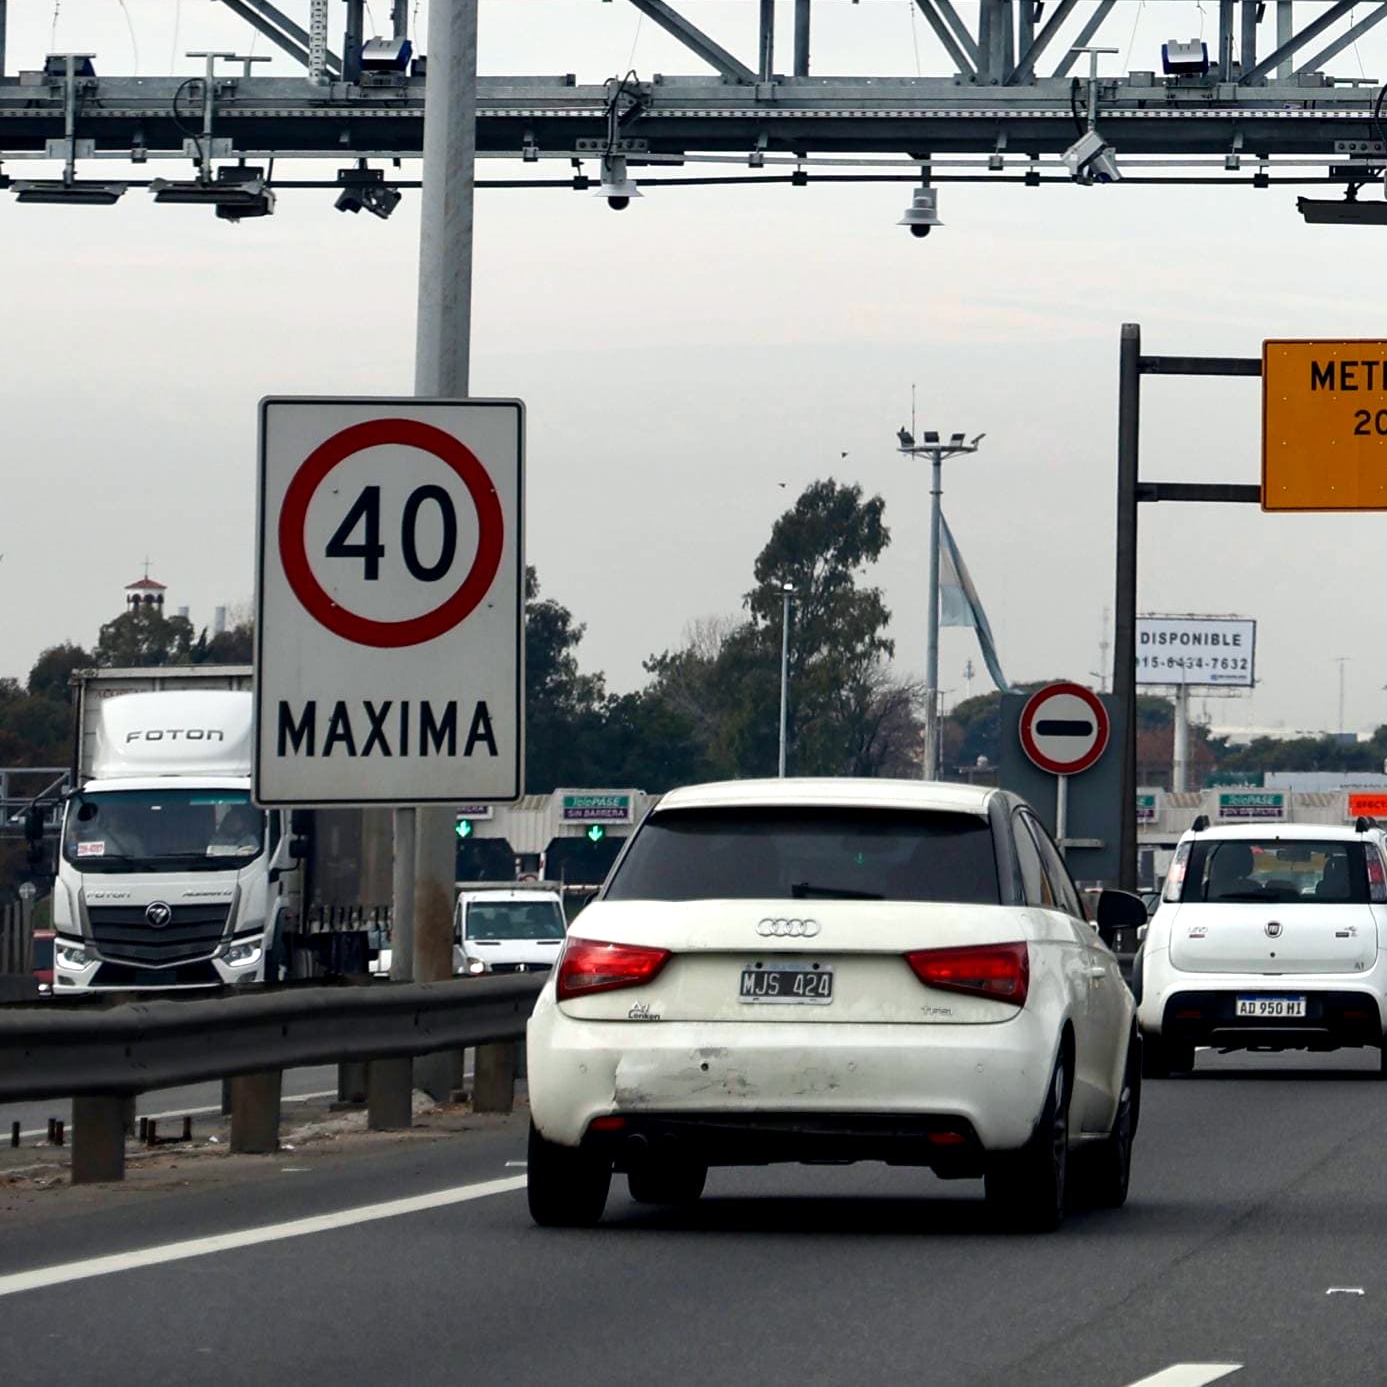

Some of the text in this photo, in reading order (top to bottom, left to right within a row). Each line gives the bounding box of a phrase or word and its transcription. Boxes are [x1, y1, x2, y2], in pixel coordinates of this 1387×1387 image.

[325, 484, 457, 582] 40
[1140, 632, 1241, 646] DISPONIBLE
[126, 729, 224, 744] FOTON
[277, 700, 499, 758] MAXIMA
[743, 973, 830, 996] MJS 424
[1240, 1002, 1302, 1015] AD 950 HI
